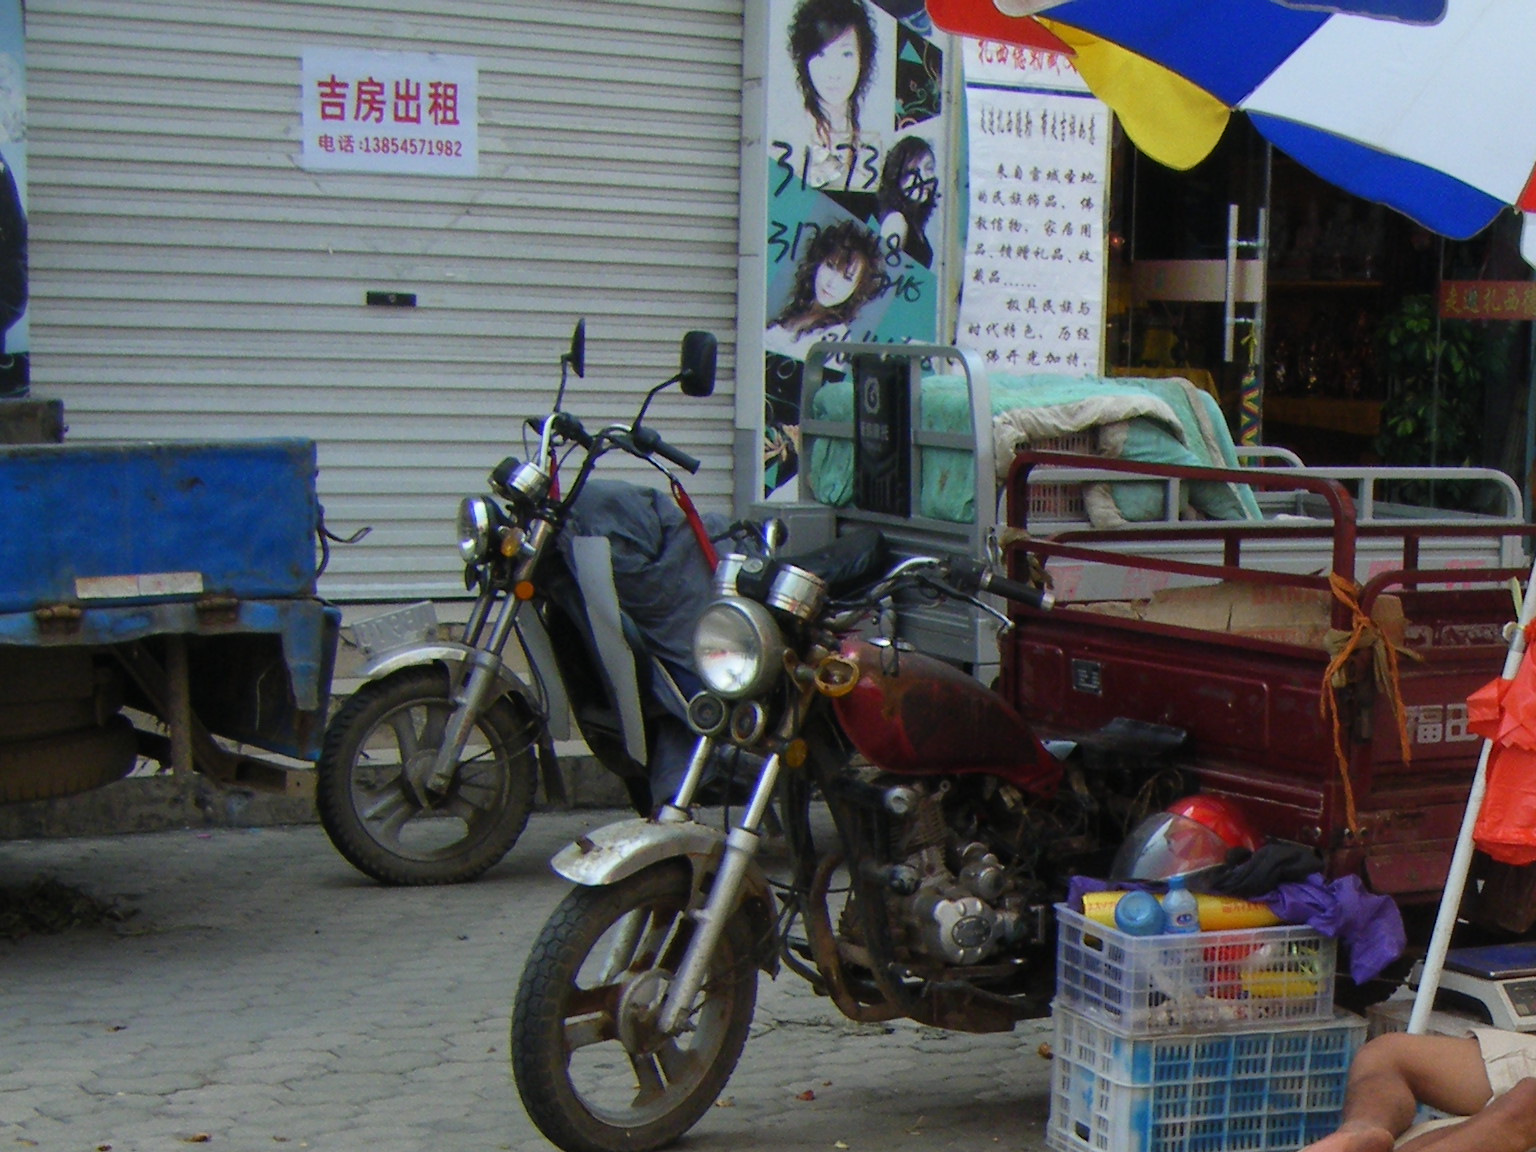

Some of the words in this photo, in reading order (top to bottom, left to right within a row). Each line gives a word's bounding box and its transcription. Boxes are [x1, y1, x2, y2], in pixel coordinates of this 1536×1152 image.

[316, 74, 460, 126] 吉房出租
[318, 134, 462, 157] 电话:13854571982
